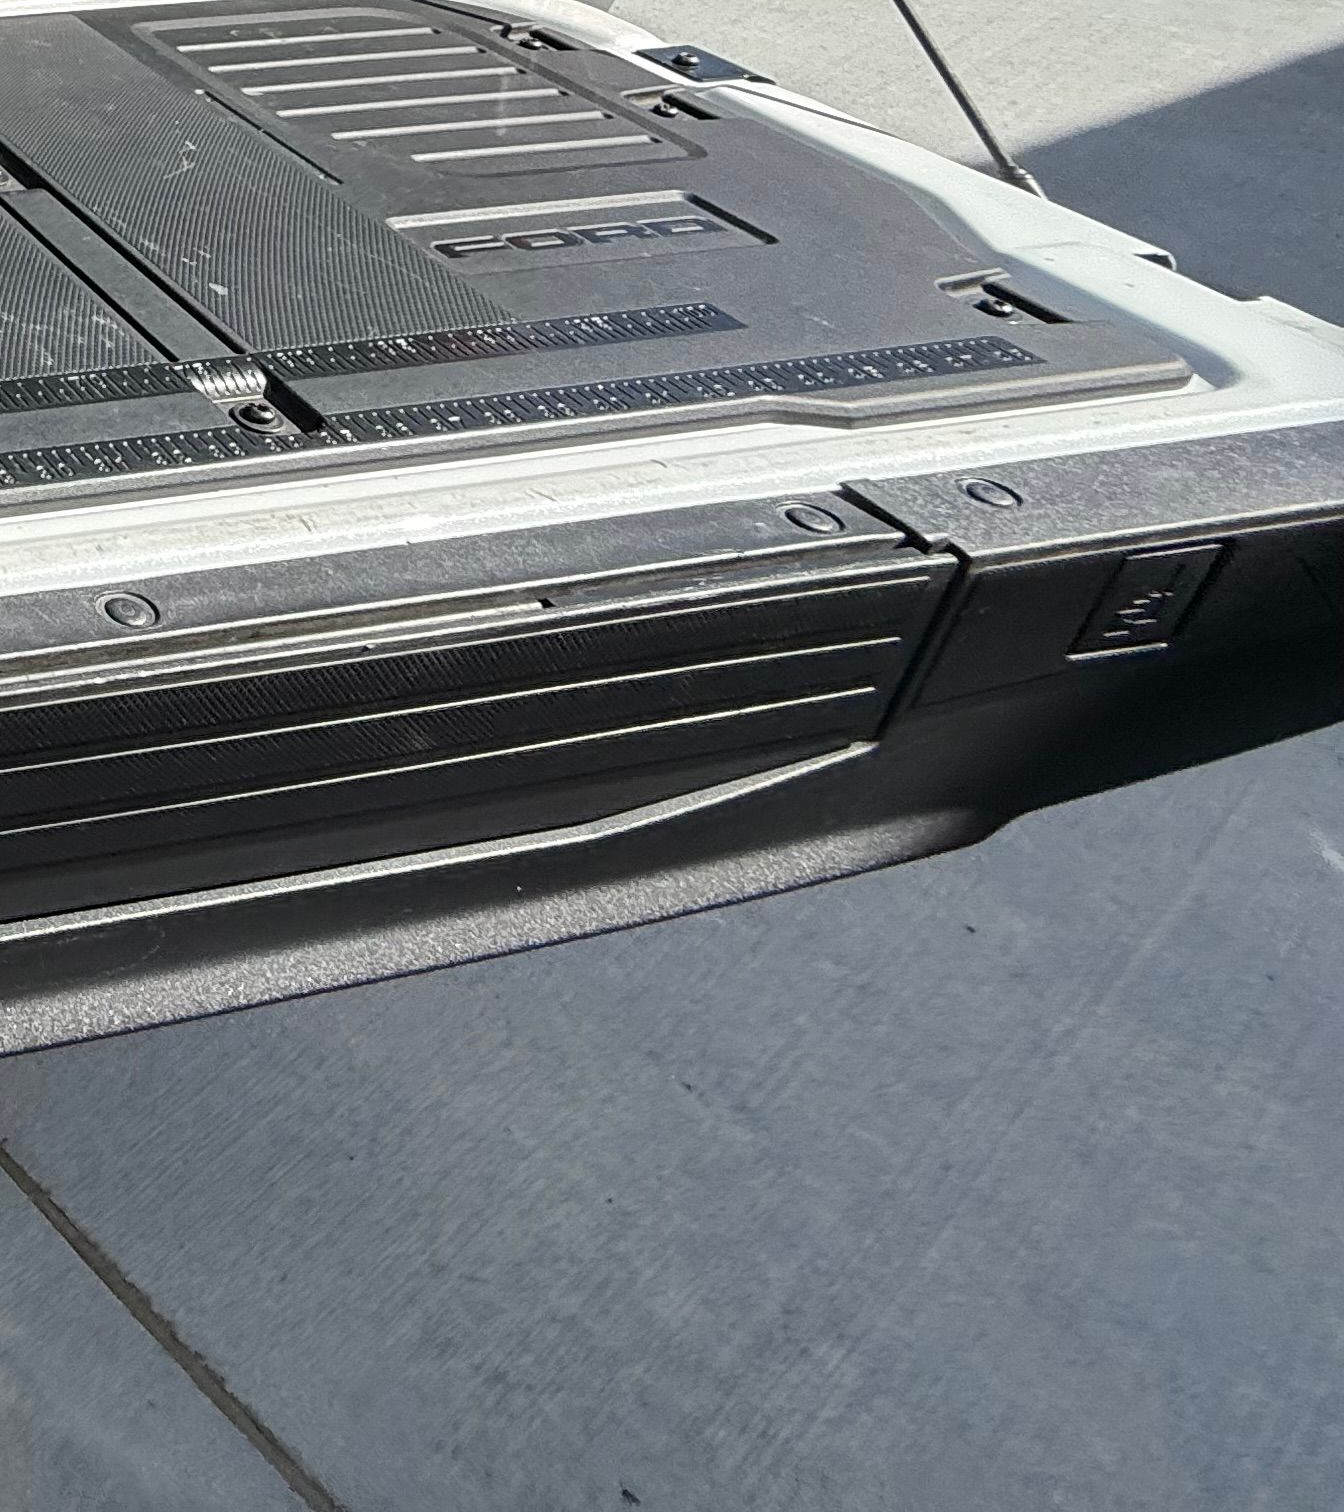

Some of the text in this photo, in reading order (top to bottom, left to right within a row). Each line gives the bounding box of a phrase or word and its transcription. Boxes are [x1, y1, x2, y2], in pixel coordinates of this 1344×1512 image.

[430, 216, 727, 259] FORD
[68, 374, 107, 393] 70
[276, 349, 315, 368] 80
[377, 338, 417, 356] 85
[476, 327, 516, 345] 90
[573, 317, 612, 333] 95
